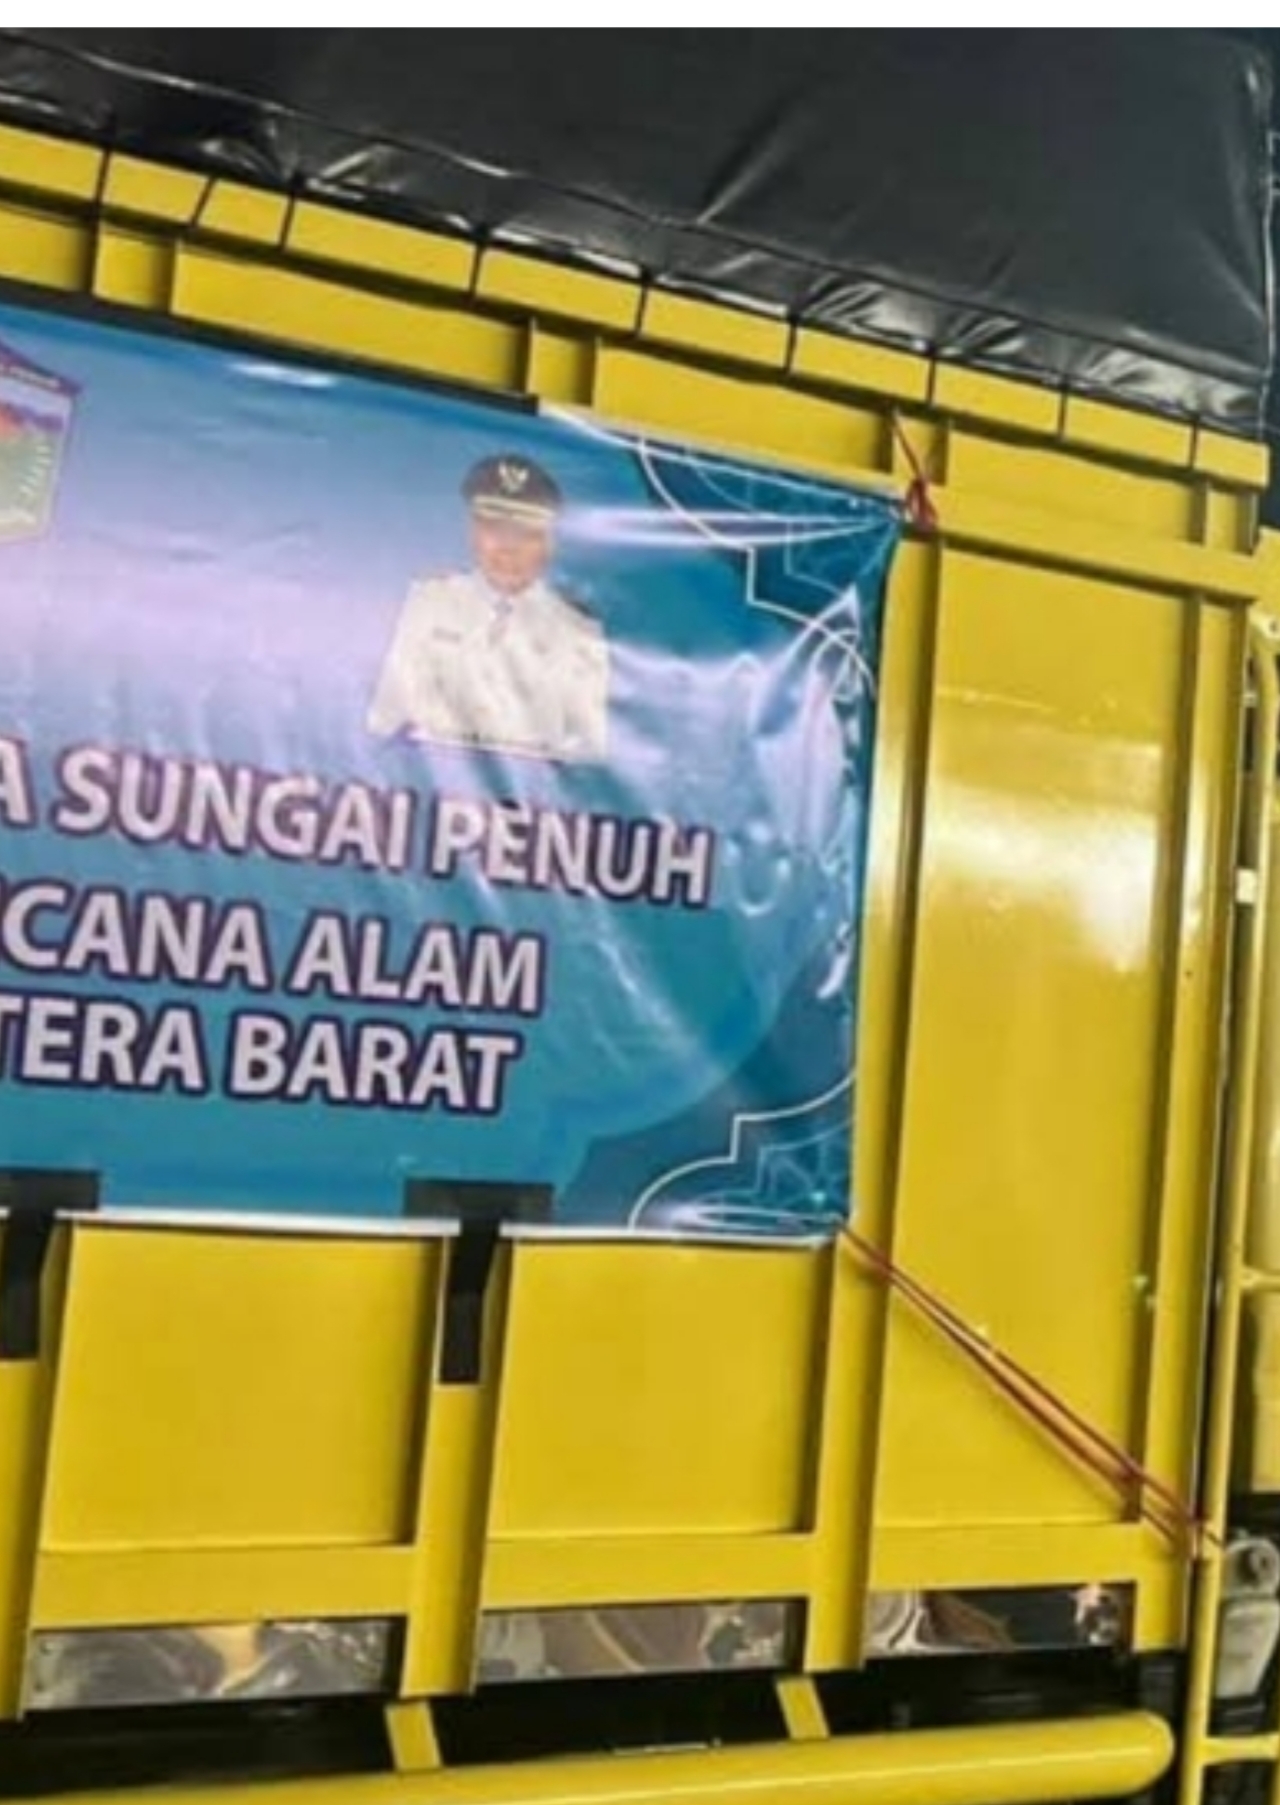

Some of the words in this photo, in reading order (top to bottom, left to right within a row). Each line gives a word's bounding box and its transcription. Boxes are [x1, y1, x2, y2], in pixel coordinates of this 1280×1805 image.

[57, 747, 412, 868] SUNGAI
[434, 803, 712, 904] PENUH
[2, 888, 267, 987] CANA
[292, 916, 542, 1012] ALAM
[231, 1015, 516, 1110] BARAT
